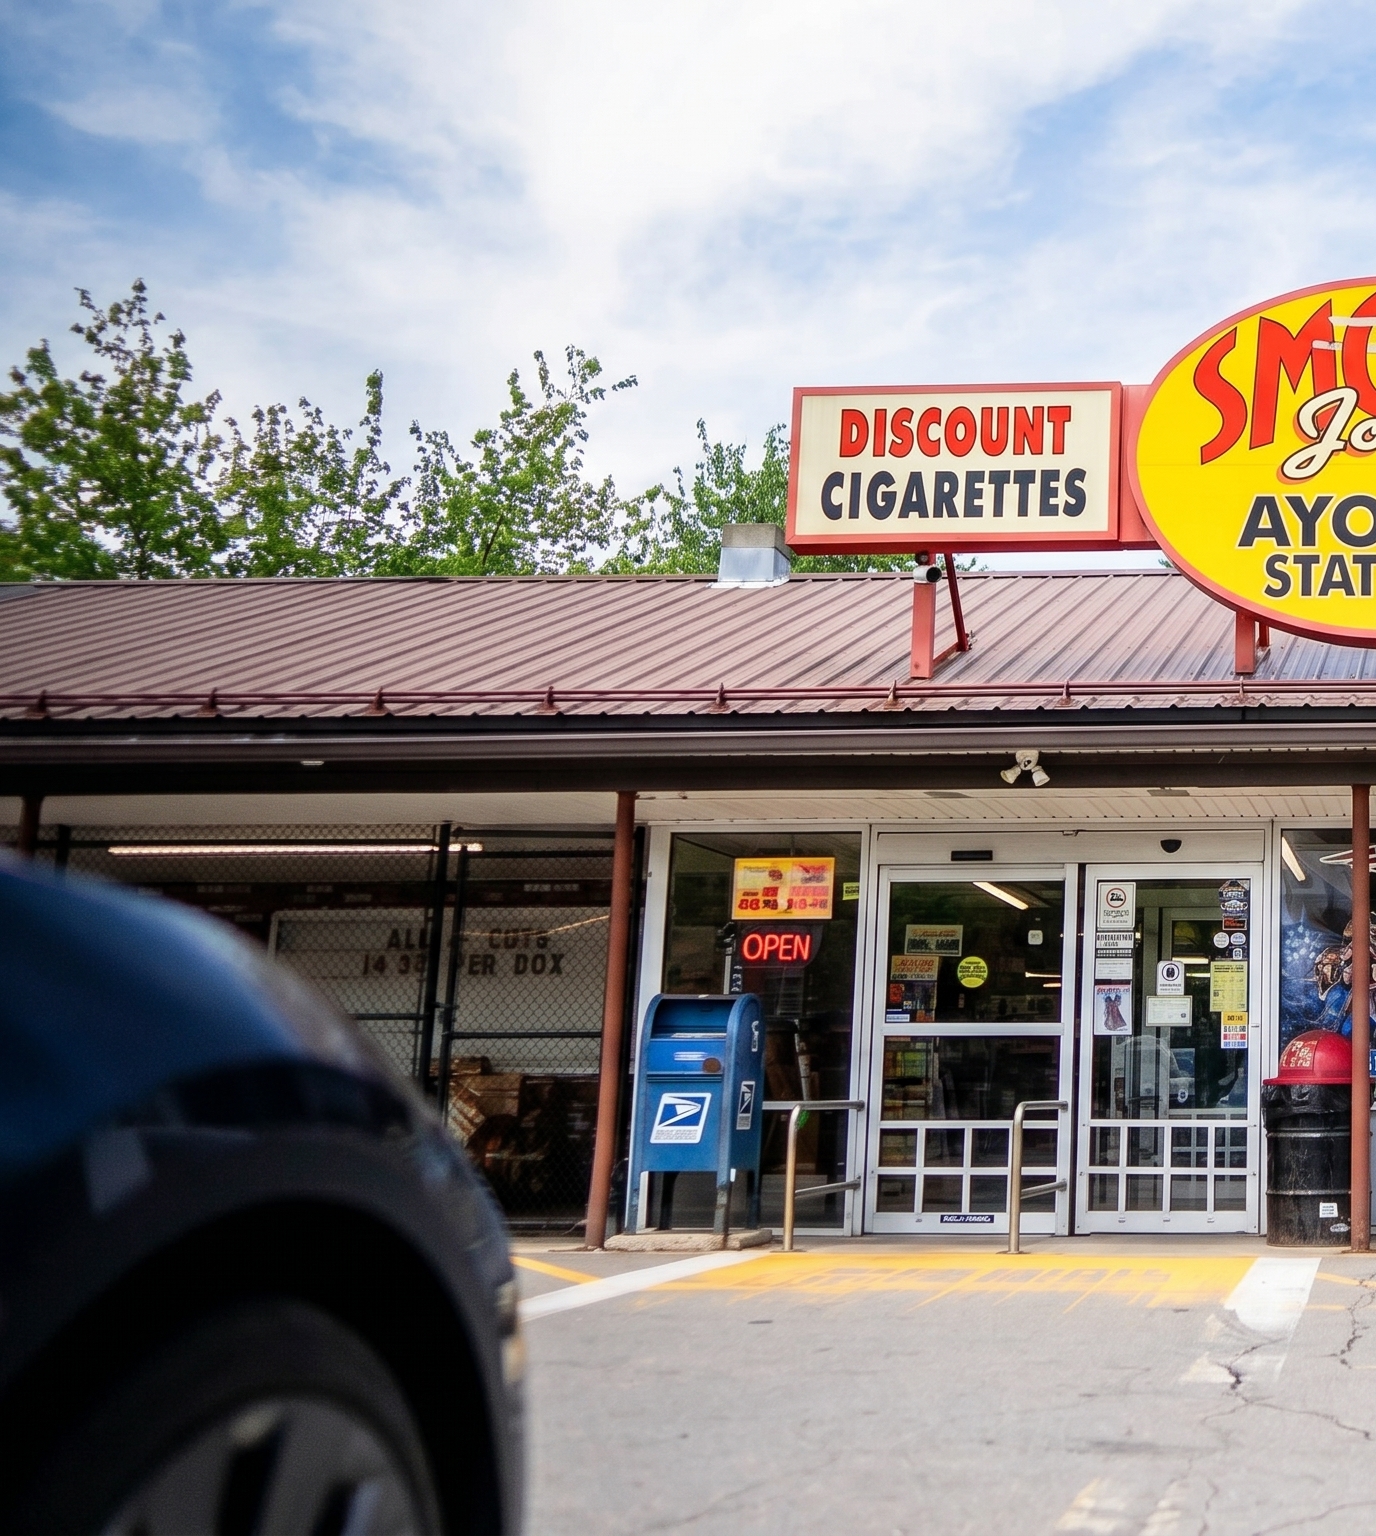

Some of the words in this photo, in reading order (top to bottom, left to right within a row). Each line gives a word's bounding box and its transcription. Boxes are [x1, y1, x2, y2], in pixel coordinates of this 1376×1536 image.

[839, 406, 1072, 458] DISCOUNT
[821, 468, 1087, 521] CIGARETTES
[743, 933, 811, 961] OPEN
